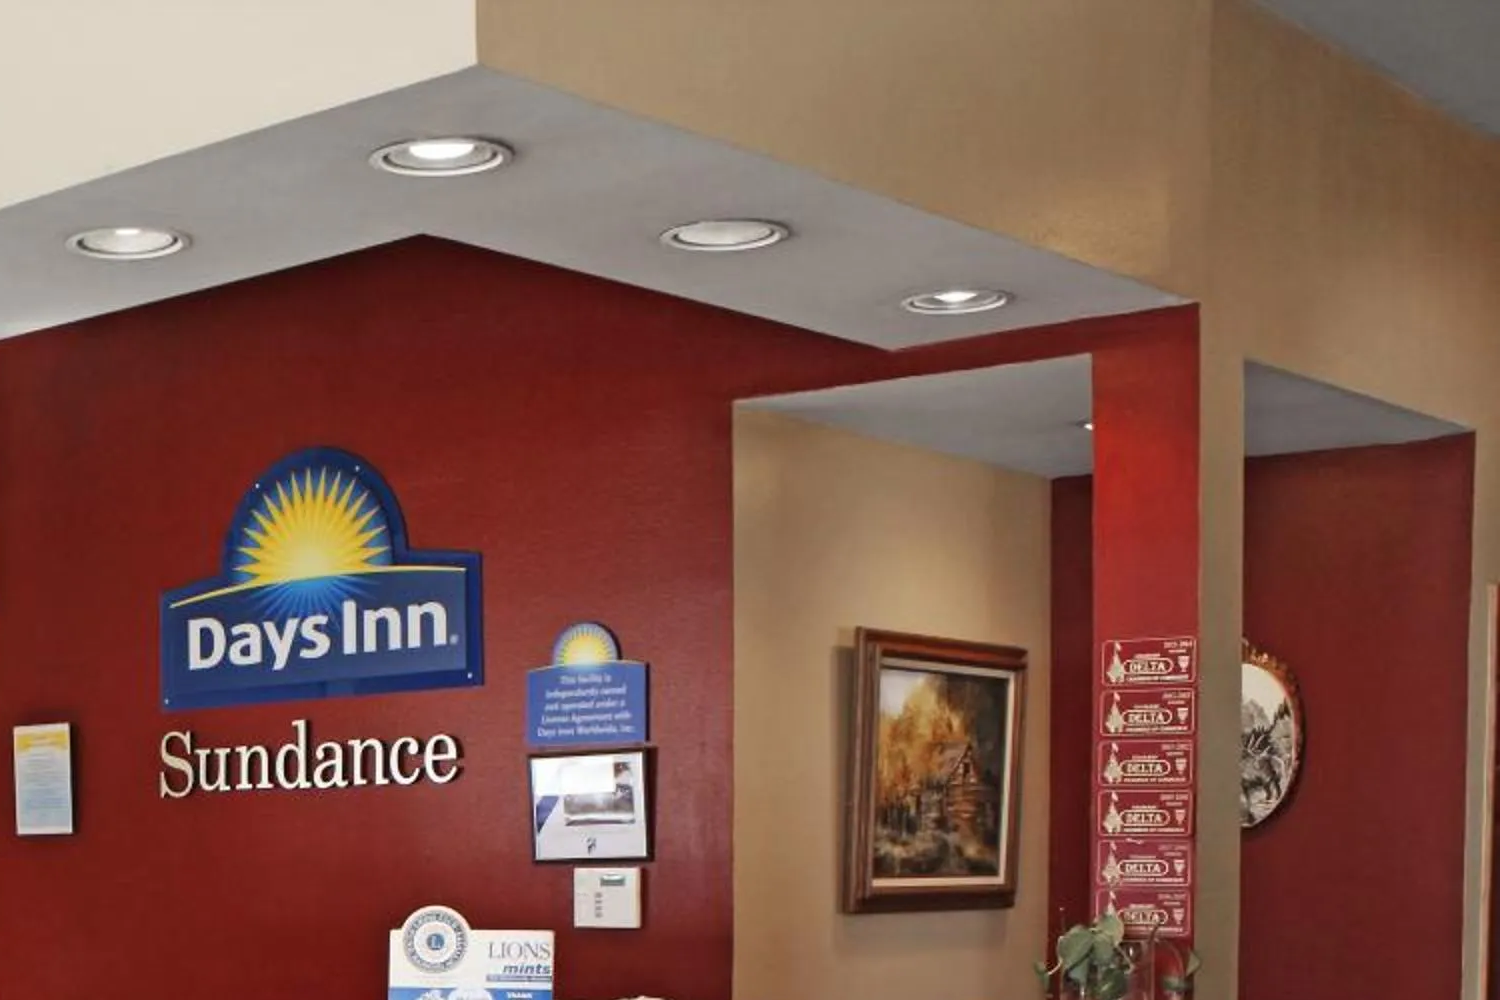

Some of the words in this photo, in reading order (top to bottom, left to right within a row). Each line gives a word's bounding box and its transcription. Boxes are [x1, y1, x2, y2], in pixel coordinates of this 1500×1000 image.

[187, 613, 331, 671] Days
[342, 600, 447, 655] Inn
[1129, 661, 1166, 673] DELTA
[1128, 712, 1165, 725] DELTA
[159, 720, 459, 798] Sundance
[1127, 763, 1162, 773] DELTA
[1126, 813, 1162, 823] DELTA
[1125, 863, 1161, 873] DELTA
[489, 942, 550, 960] LIONS
[503, 964, 550, 975] mints
